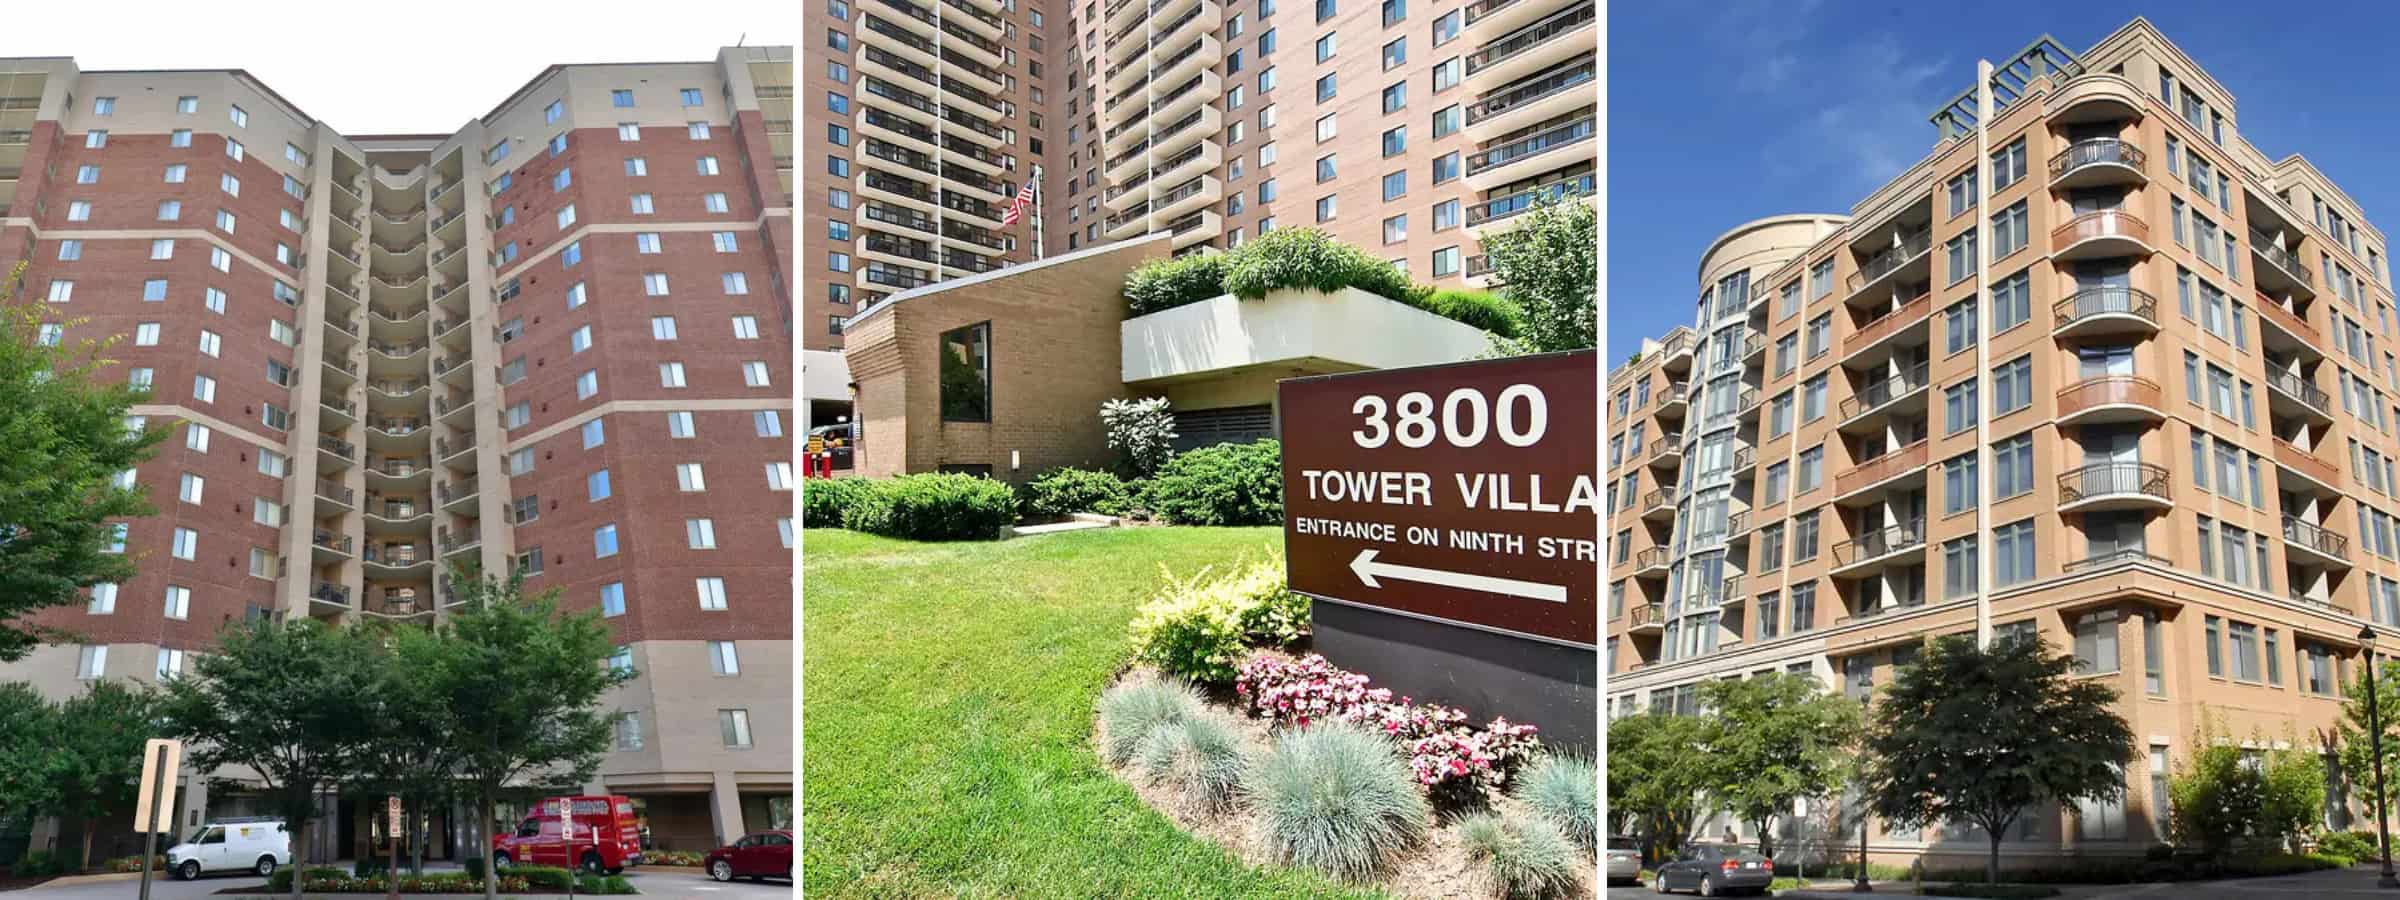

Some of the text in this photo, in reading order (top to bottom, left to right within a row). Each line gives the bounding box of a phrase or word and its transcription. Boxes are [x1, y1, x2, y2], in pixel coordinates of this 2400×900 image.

[1352, 383, 1547, 449] 3800
[1302, 470, 1597, 514] TOWER VILLA
[1296, 517, 1597, 562] ENTRANCE ON NINTH STR
